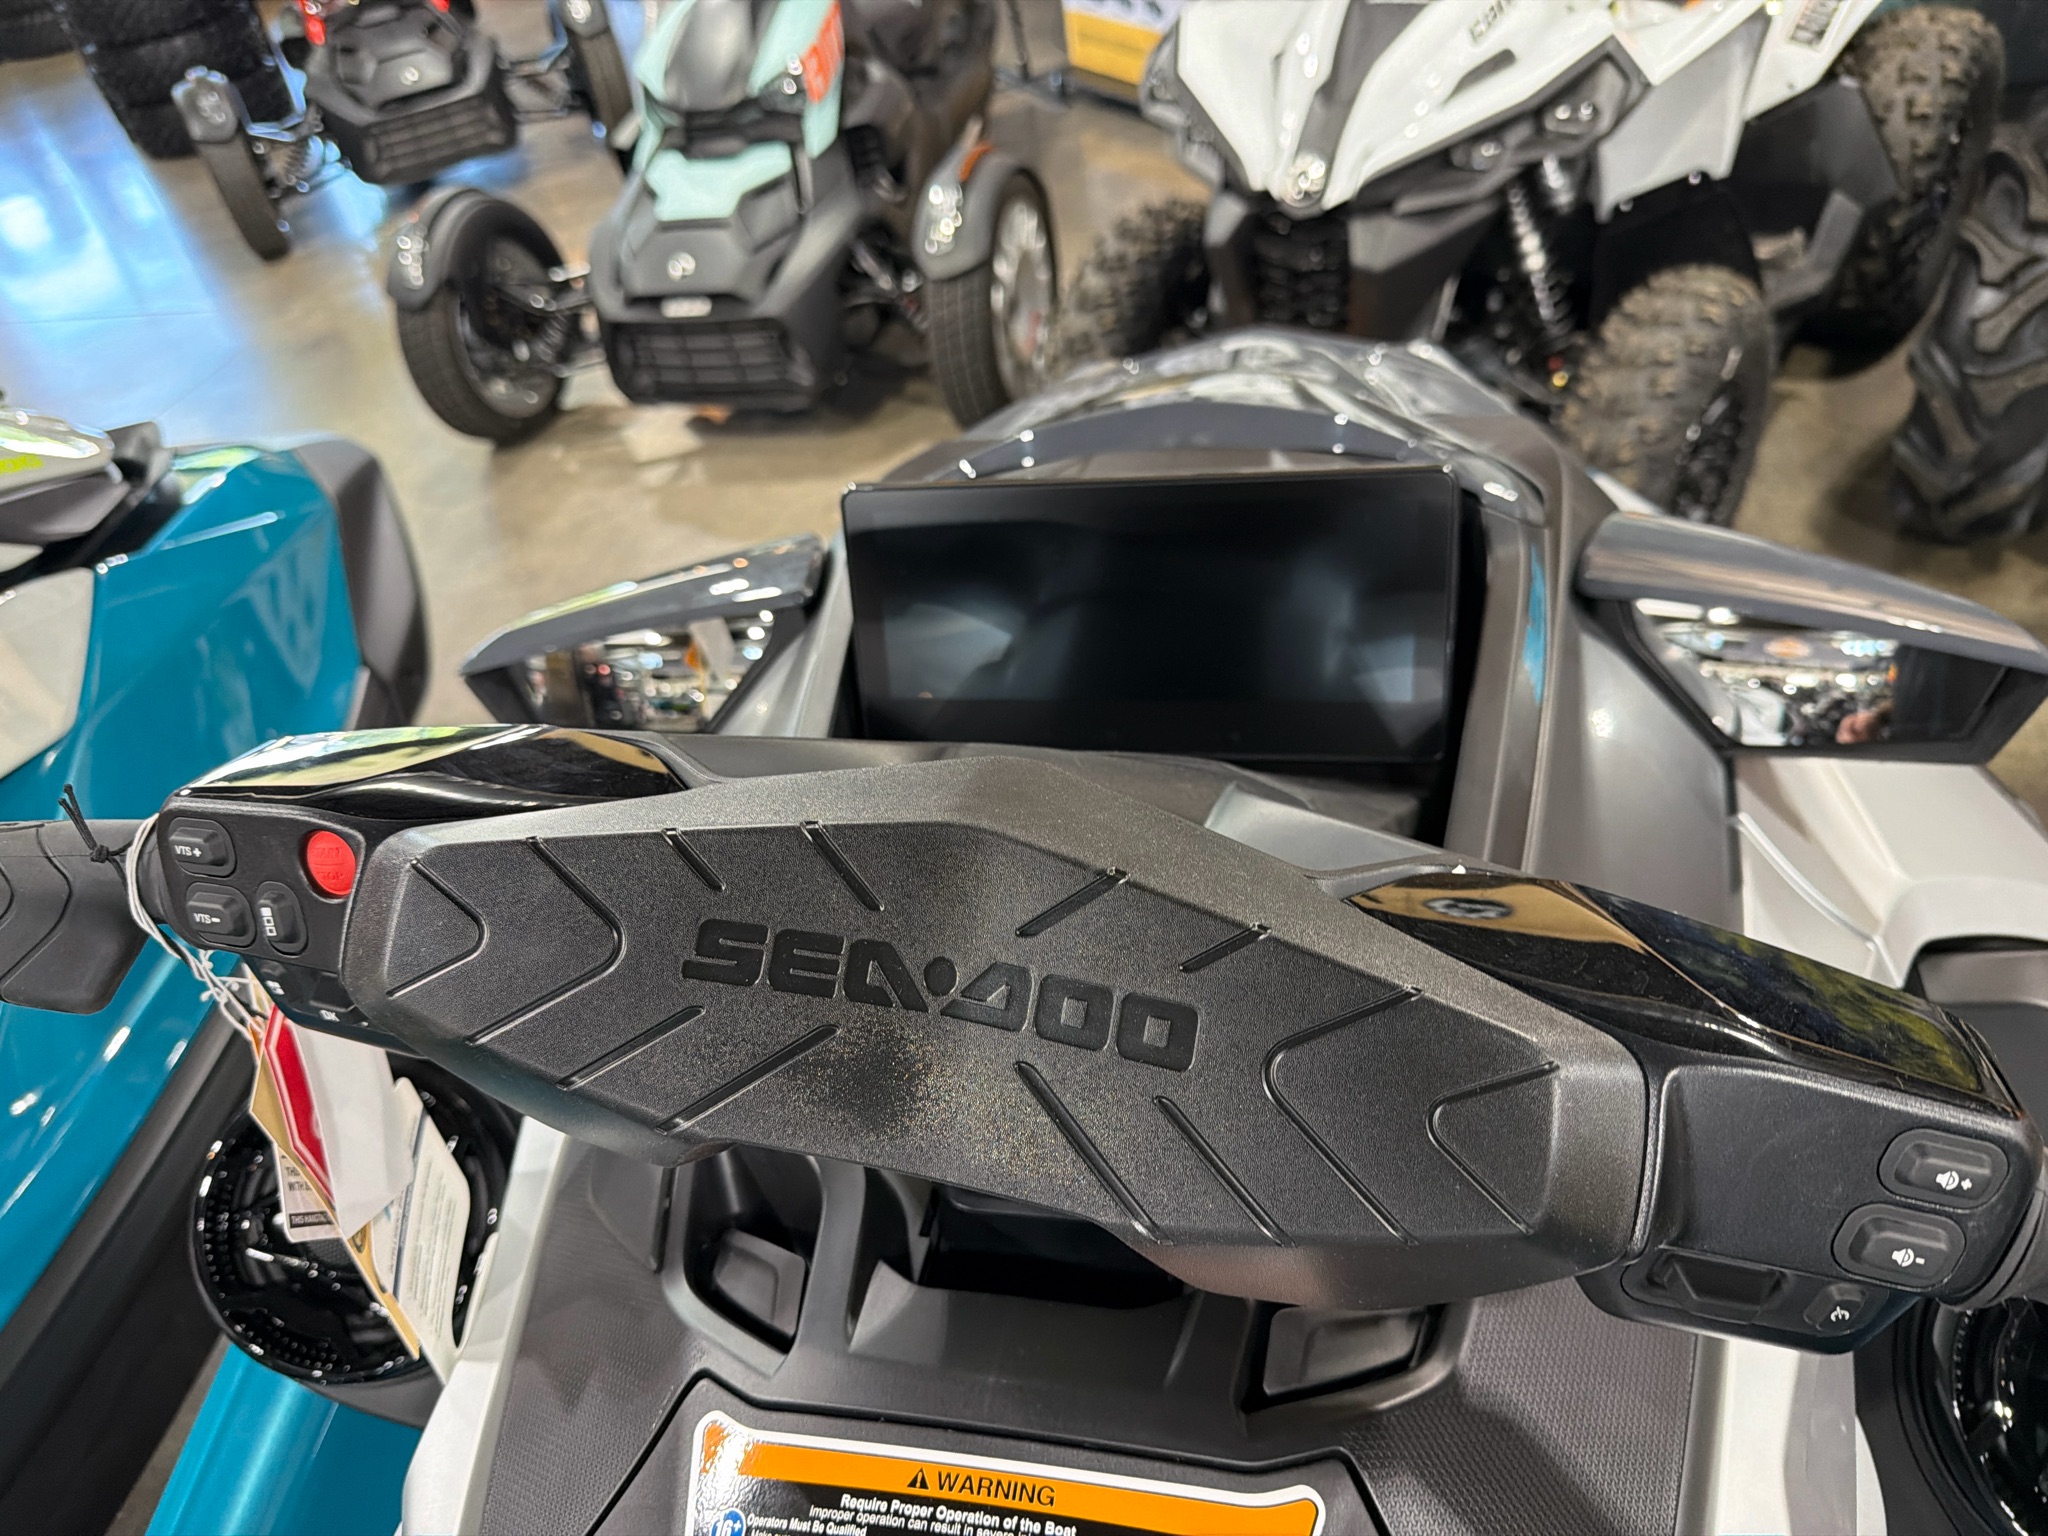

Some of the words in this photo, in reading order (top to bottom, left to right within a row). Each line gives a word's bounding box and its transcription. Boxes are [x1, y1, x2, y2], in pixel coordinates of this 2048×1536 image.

[937, 1471, 1056, 1507] WARNING
[747, 1512, 788, 1530] Operators
[789, 1517, 811, 1533] Must
[812, 1520, 825, 1533] Be
[825, 1522, 868, 1536] Qualified
[809, 1505, 855, 1522] Improper
[856, 1512, 905, 1529] operation
[907, 1518, 928, 1531] can
[930, 1521, 961, 1536] result
[963, 1523, 974, 1536] in
[840, 1493, 888, 1512] Require
[890, 1499, 934, 1519] Proper
[936, 1505, 1000, 1528] Operation
[1003, 1515, 1019, 1531] of
[1020, 1516, 1042, 1534] the
[1044, 1520, 1077, 1536] Boat
